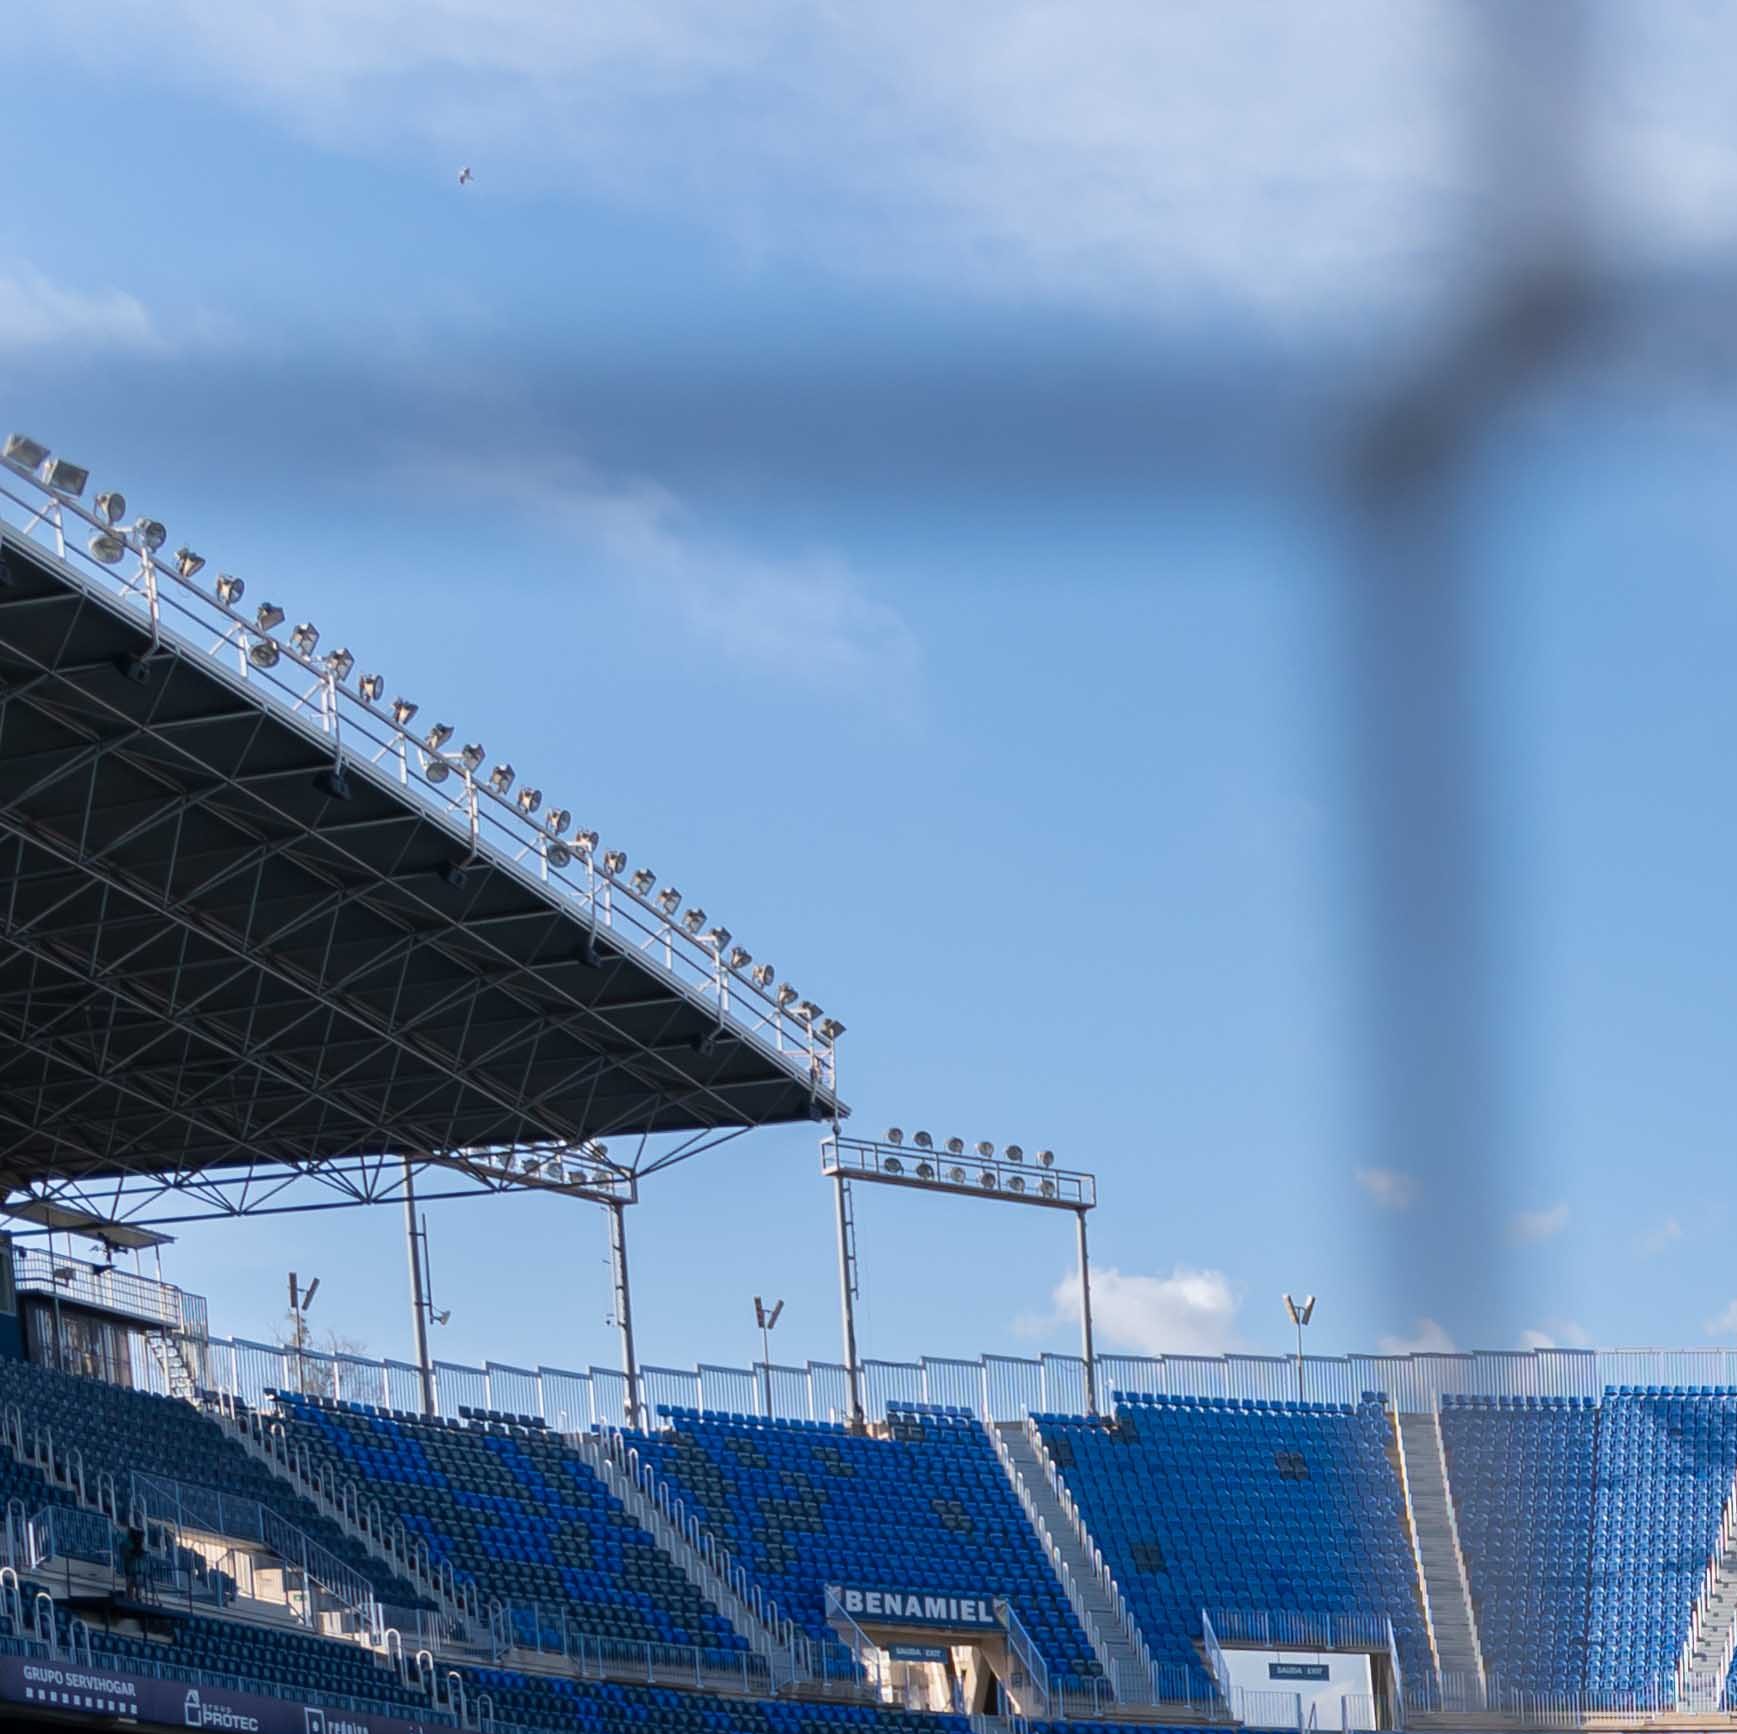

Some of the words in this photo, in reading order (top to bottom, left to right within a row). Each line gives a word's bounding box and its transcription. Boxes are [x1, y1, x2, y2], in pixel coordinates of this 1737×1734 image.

[845, 1590, 994, 1622] BENAMIEL
[23, 1665, 64, 1685] GRUPO
[65, 1672, 136, 1697] SERVIHOGAR
[203, 1711, 259, 1732] PROTEC
